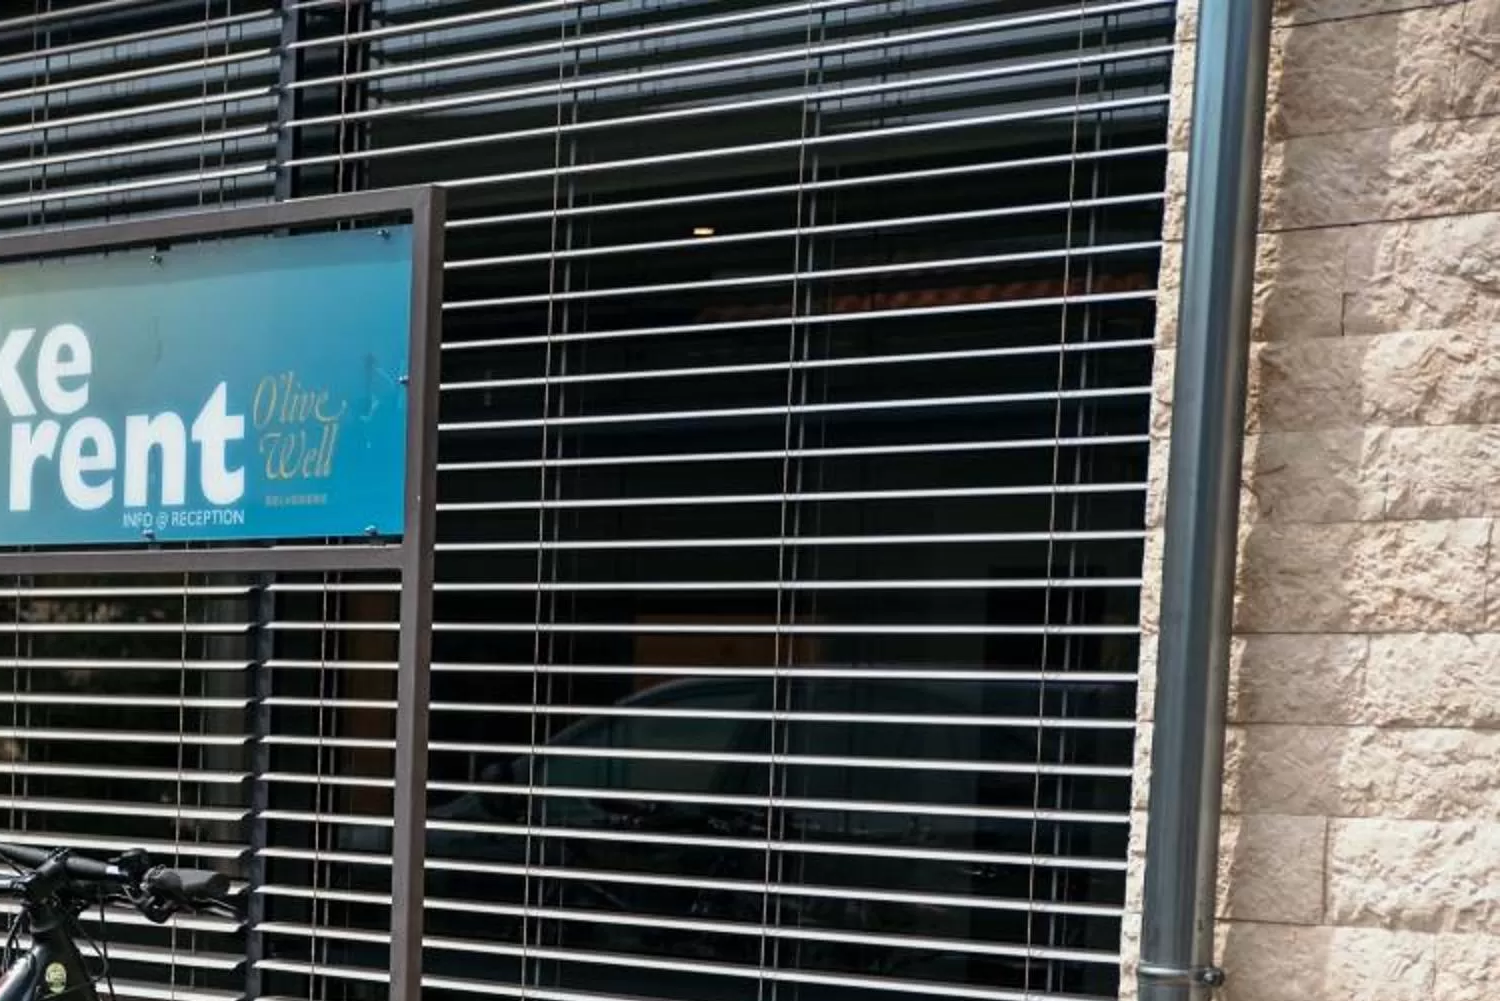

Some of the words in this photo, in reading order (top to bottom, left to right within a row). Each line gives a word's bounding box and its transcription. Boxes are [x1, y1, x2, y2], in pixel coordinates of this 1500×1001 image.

[8, 380, 246, 512] rent
[258, 422, 339, 480] Well
[122, 510, 153, 529] INFO
[171, 508, 246, 527] RECEPTION
